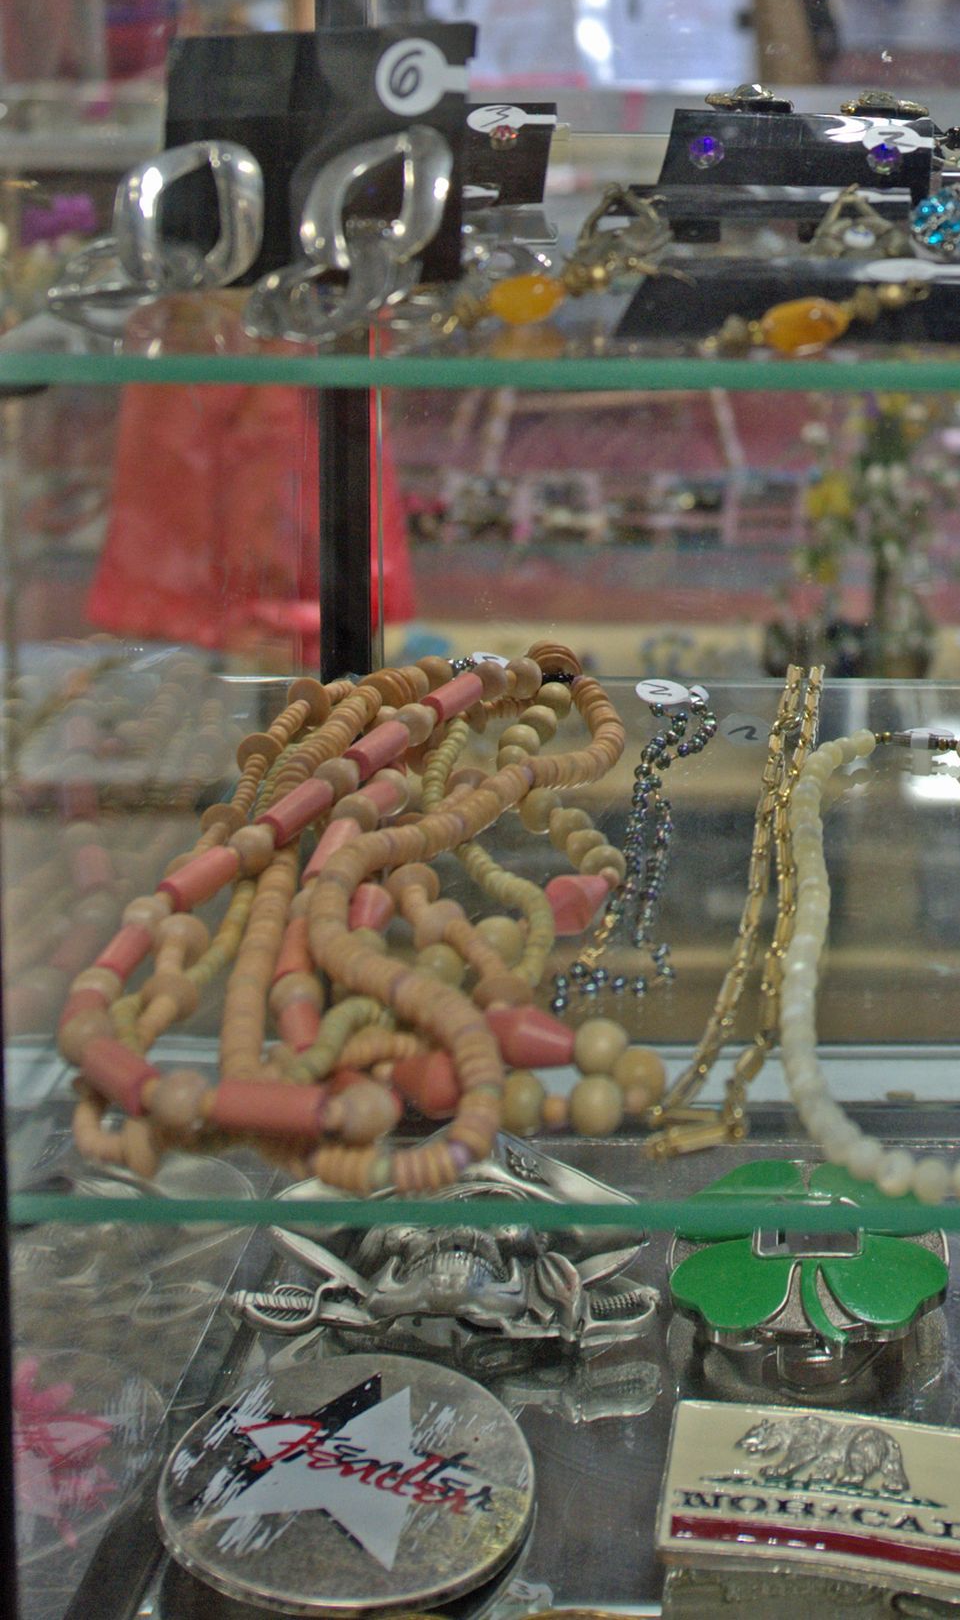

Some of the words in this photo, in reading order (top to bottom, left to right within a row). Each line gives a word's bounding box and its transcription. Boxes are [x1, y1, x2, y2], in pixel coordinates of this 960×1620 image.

[389, 49, 424, 99] 6
[479, 106, 513, 128] 3
[238, 1412, 484, 1515] Fender
